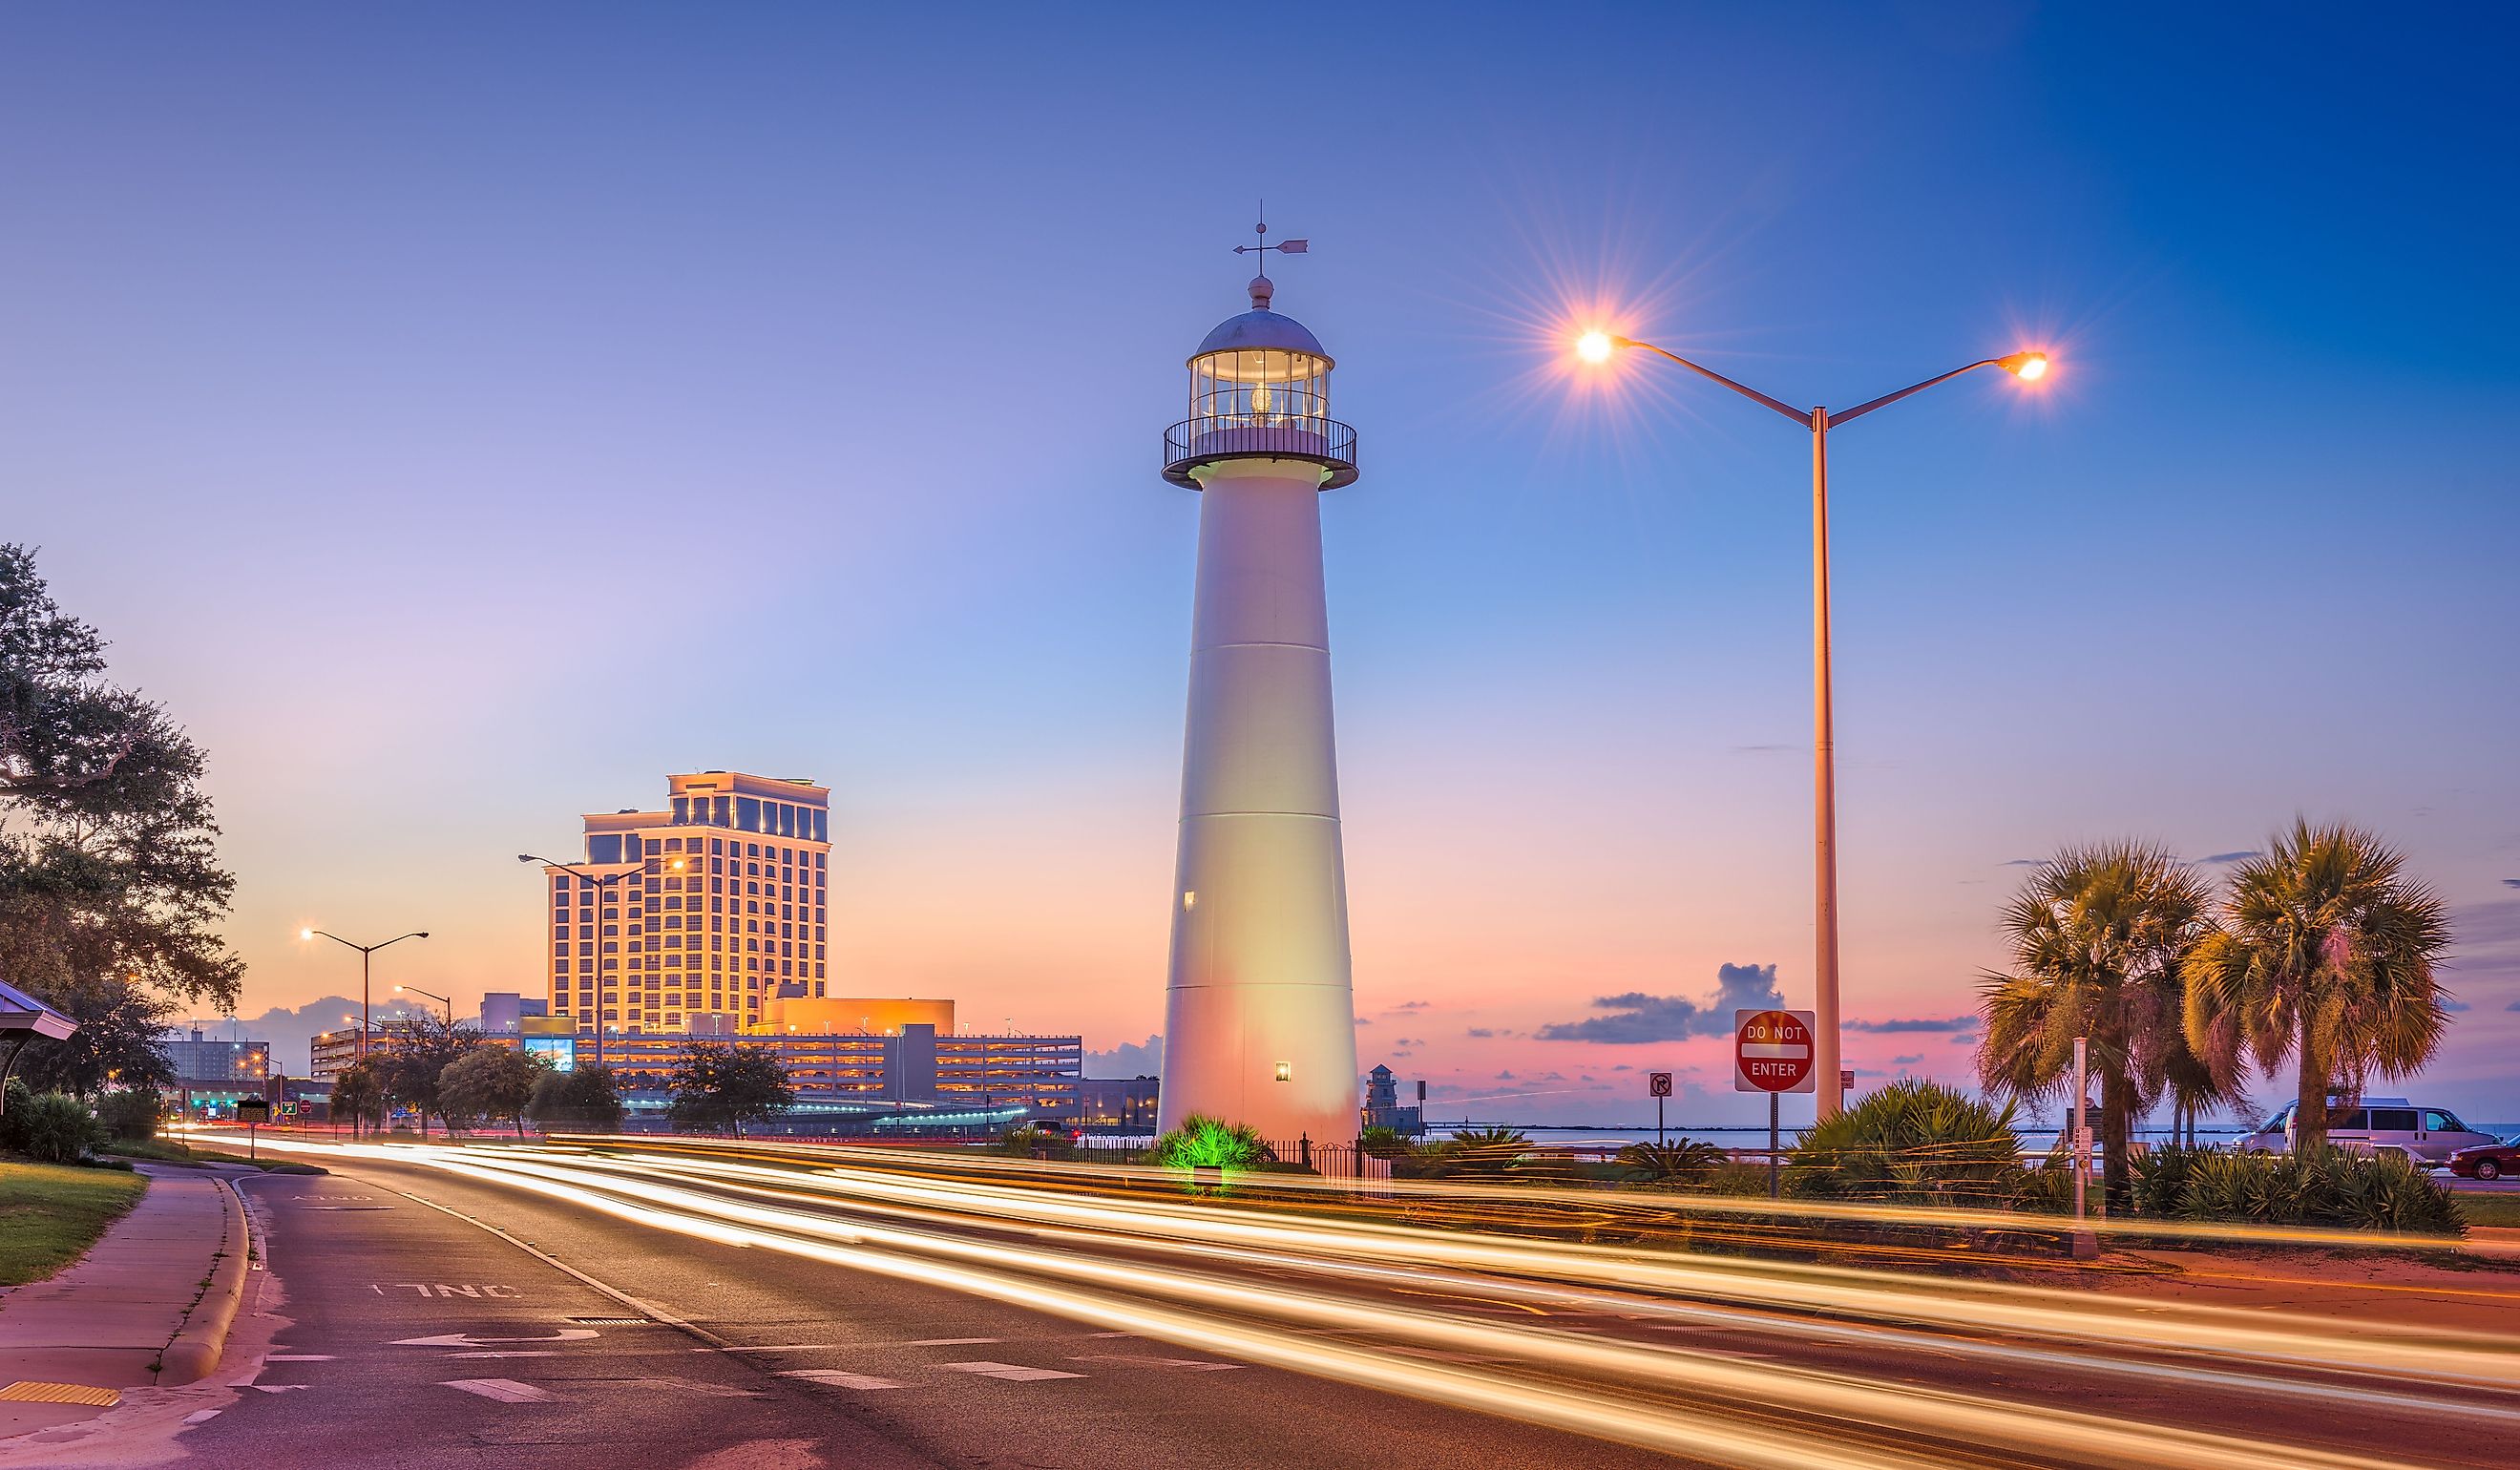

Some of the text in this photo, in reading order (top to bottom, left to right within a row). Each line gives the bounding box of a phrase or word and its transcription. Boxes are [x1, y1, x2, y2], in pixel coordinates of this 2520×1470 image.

[1748, 1026, 1802, 1040] DO NOT
[1752, 1062, 1796, 1076] ENTER
